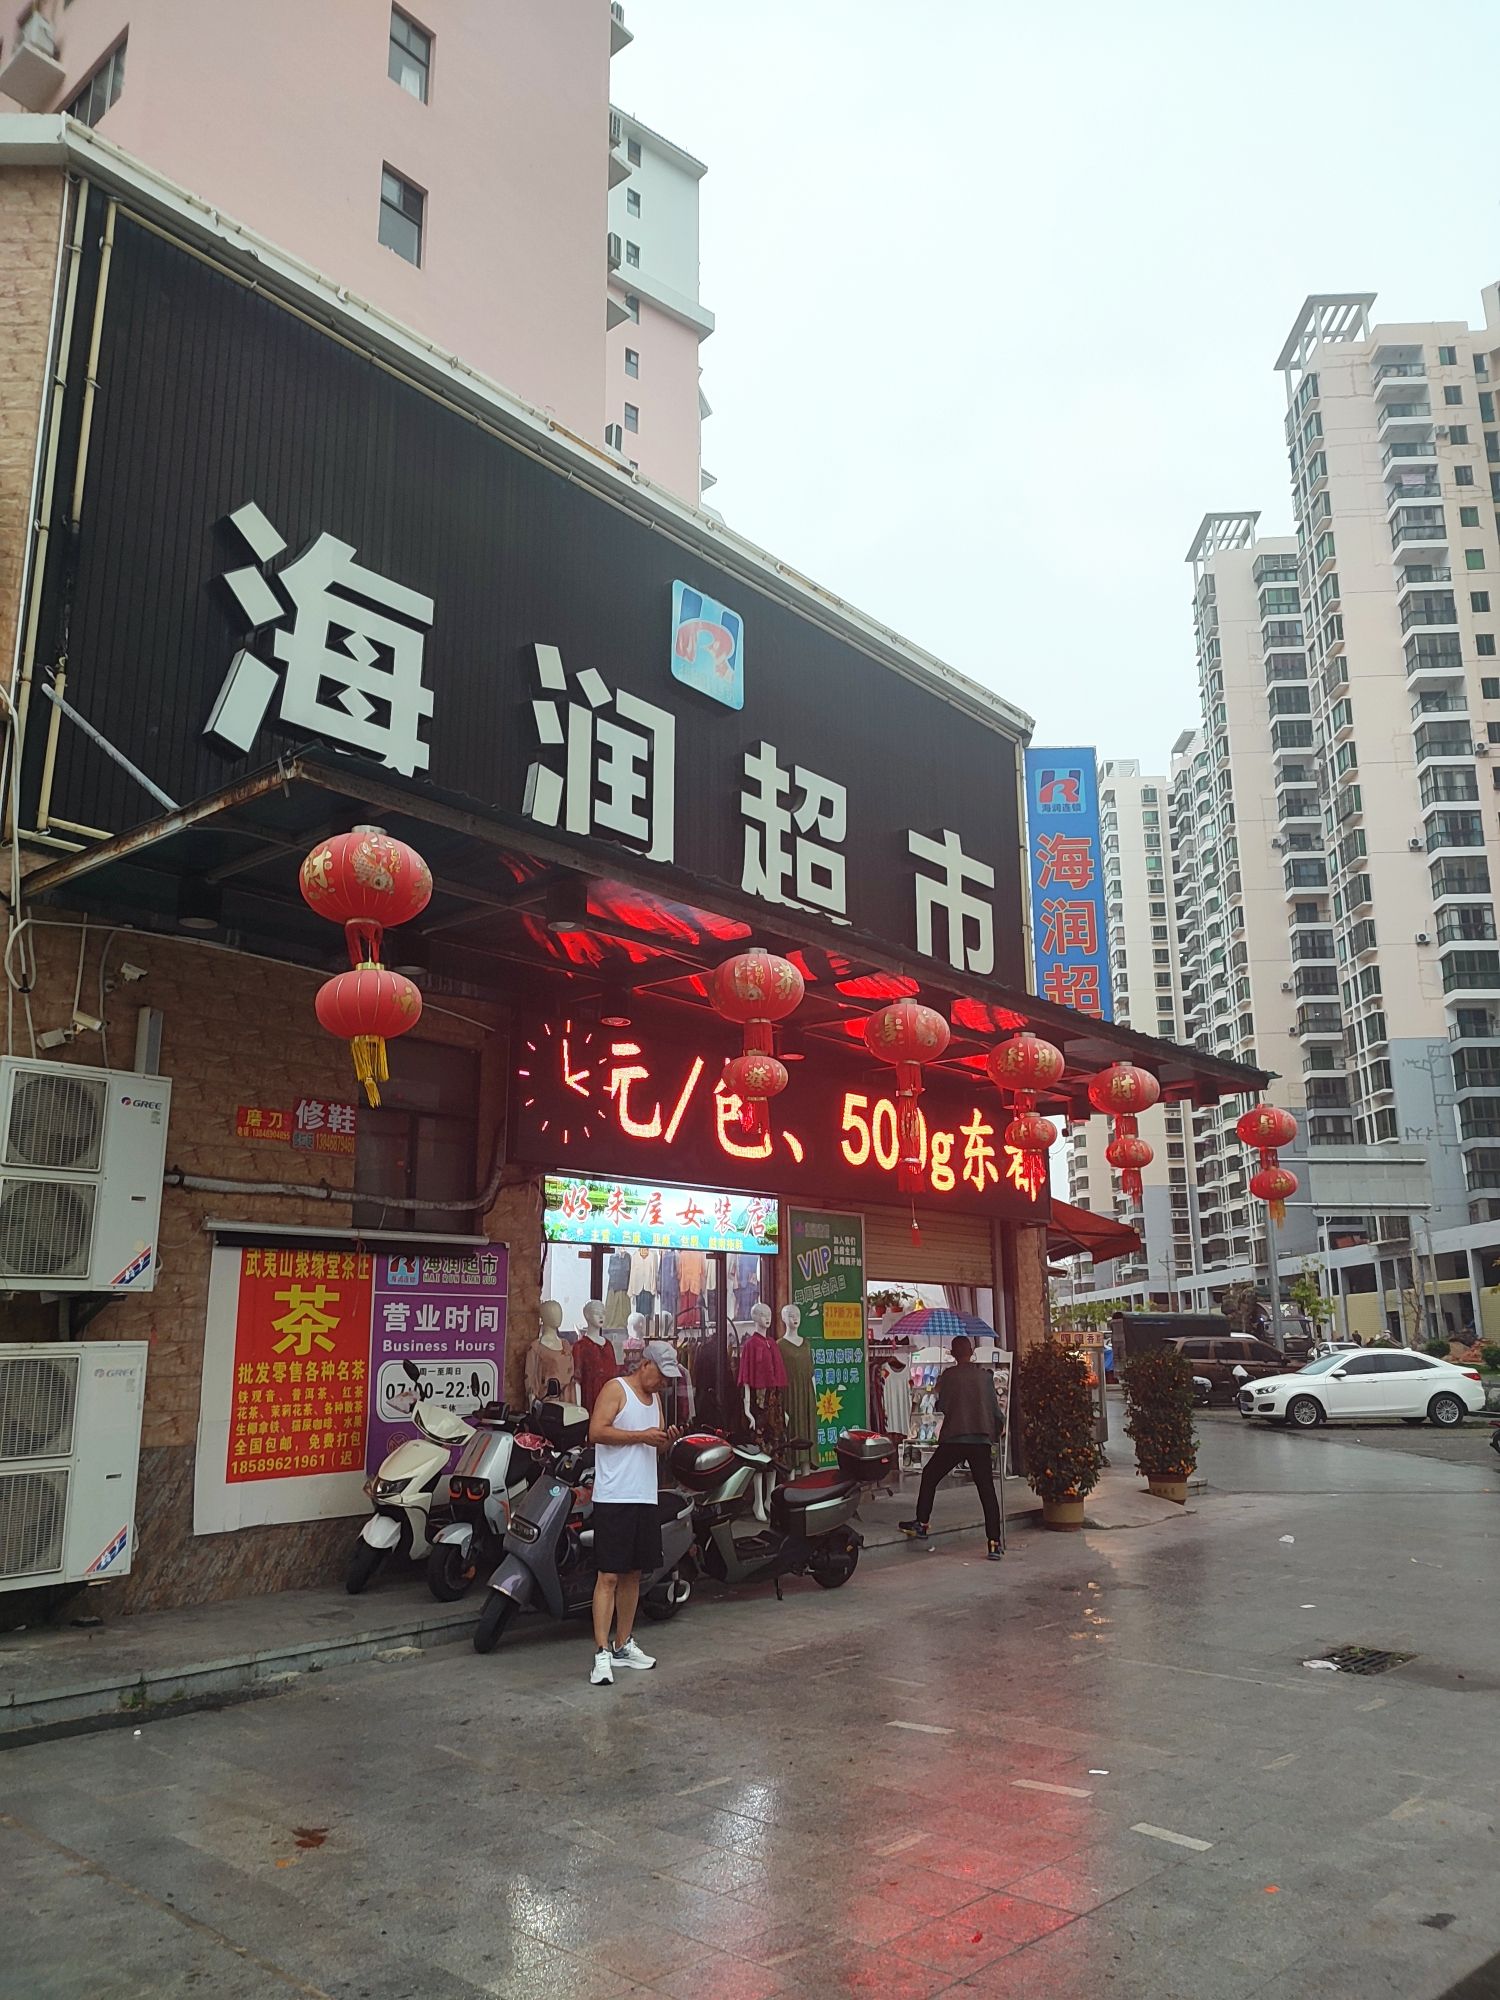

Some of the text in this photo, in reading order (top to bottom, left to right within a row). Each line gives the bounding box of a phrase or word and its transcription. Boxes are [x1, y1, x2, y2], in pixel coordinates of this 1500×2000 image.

[203, 500, 995, 976] 海润超市
[246, 1109, 283, 1129] 磨刀
[296, 1100, 356, 1134] 修鞋
[561, 1185, 767, 1237] 好来屋女装店
[797, 1245, 831, 1281] VIP
[271, 1284, 341, 1356] 茶
[382, 1303, 499, 1333] 营业时间
[383, 1340, 496, 1352] Business Hours
[811, 1347, 863, 1364] 送双倍积分
[238, 1360, 365, 1384] 批发零售各种名茶
